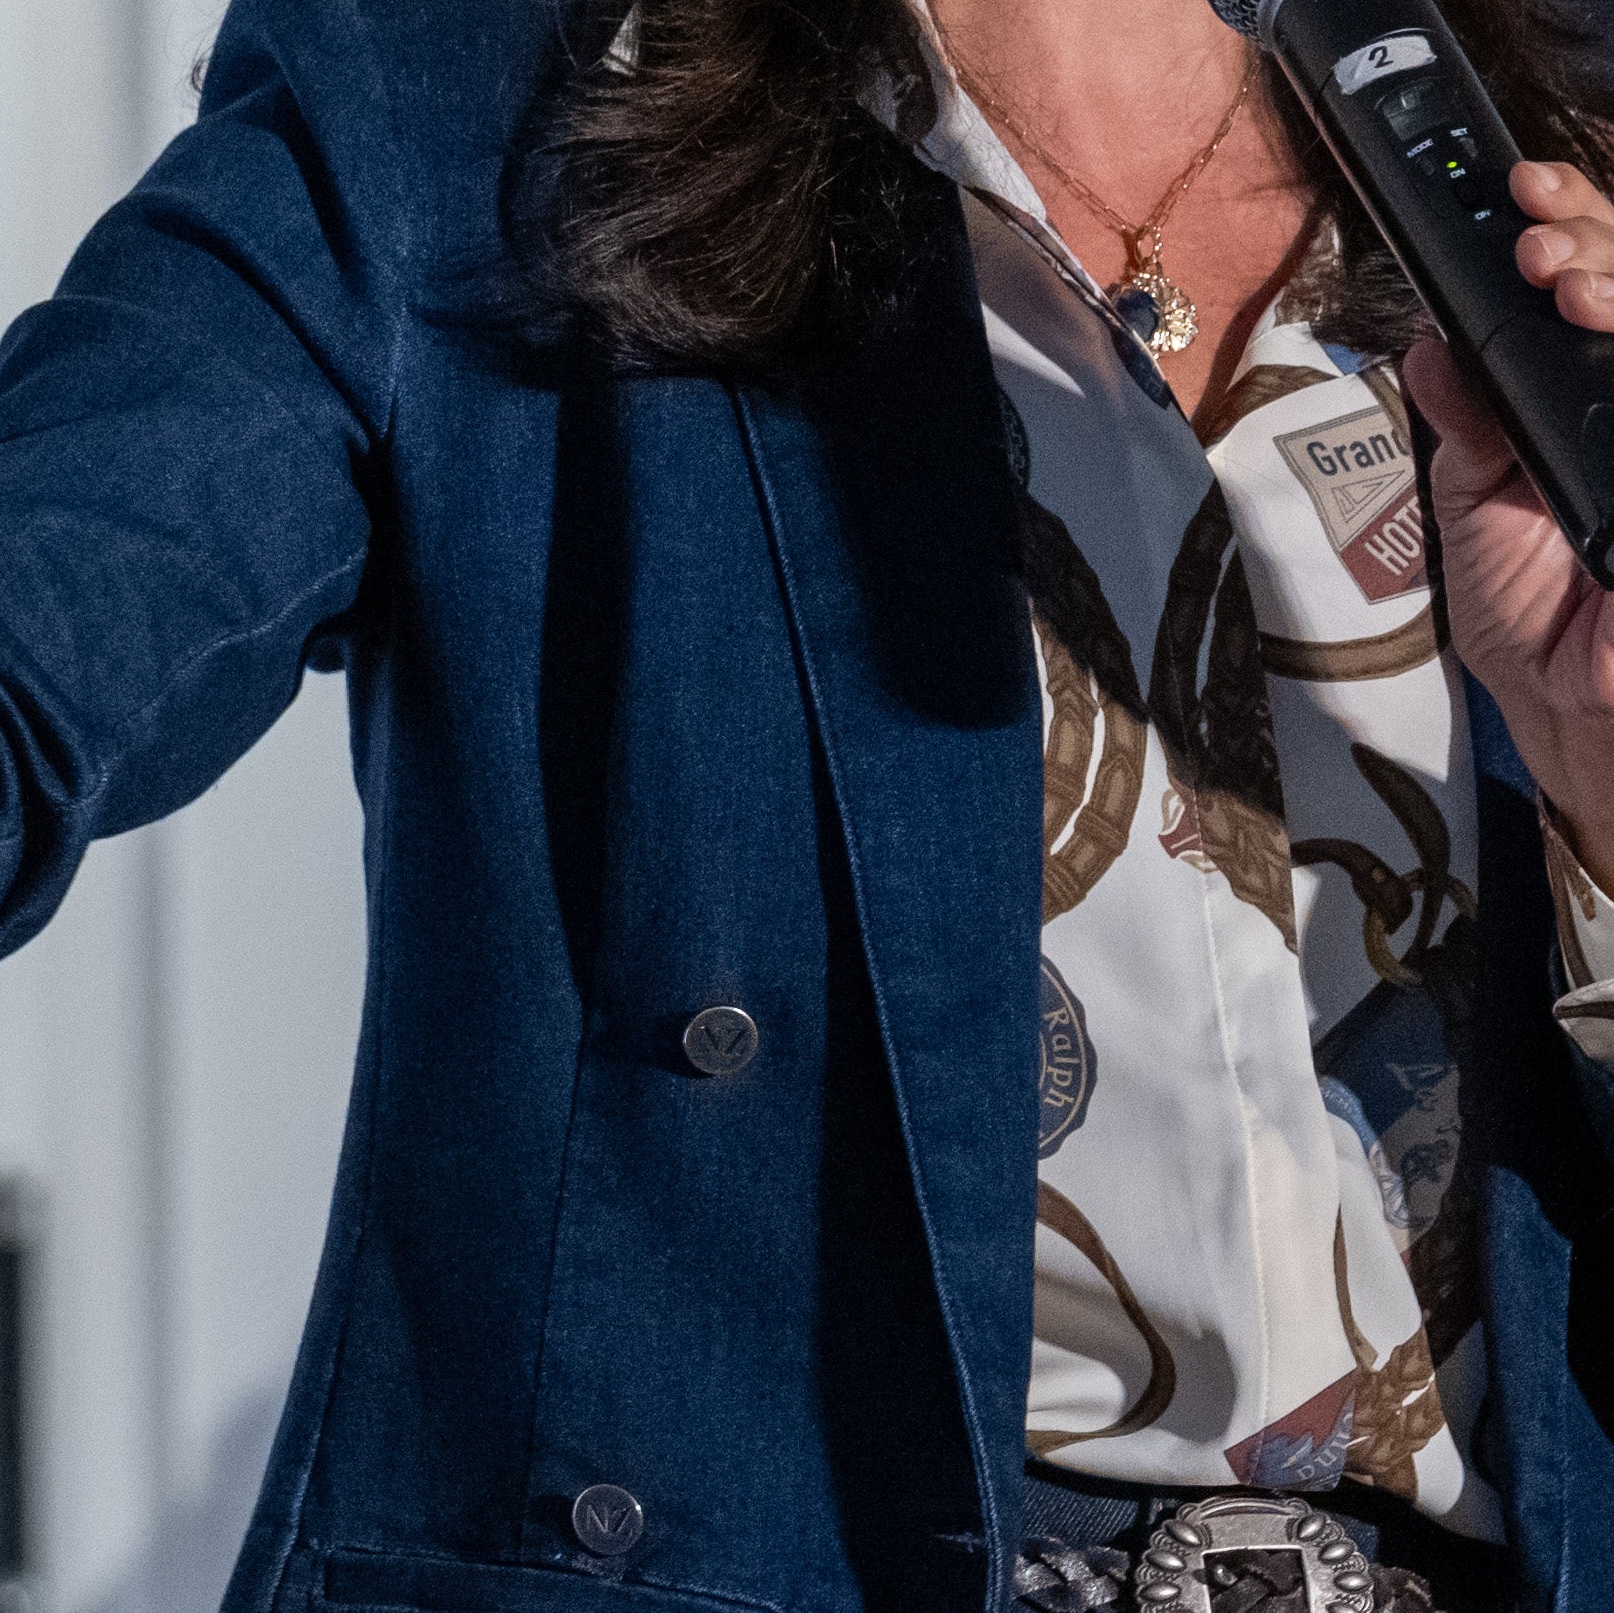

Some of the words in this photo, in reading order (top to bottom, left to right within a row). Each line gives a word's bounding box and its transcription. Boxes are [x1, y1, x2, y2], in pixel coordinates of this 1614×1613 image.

[1368, 45, 1394, 69] 2
[1406, 138, 1434, 159] MODE
[1450, 167, 1466, 179] ON
[1044, 1006, 1080, 1109] Ralph
